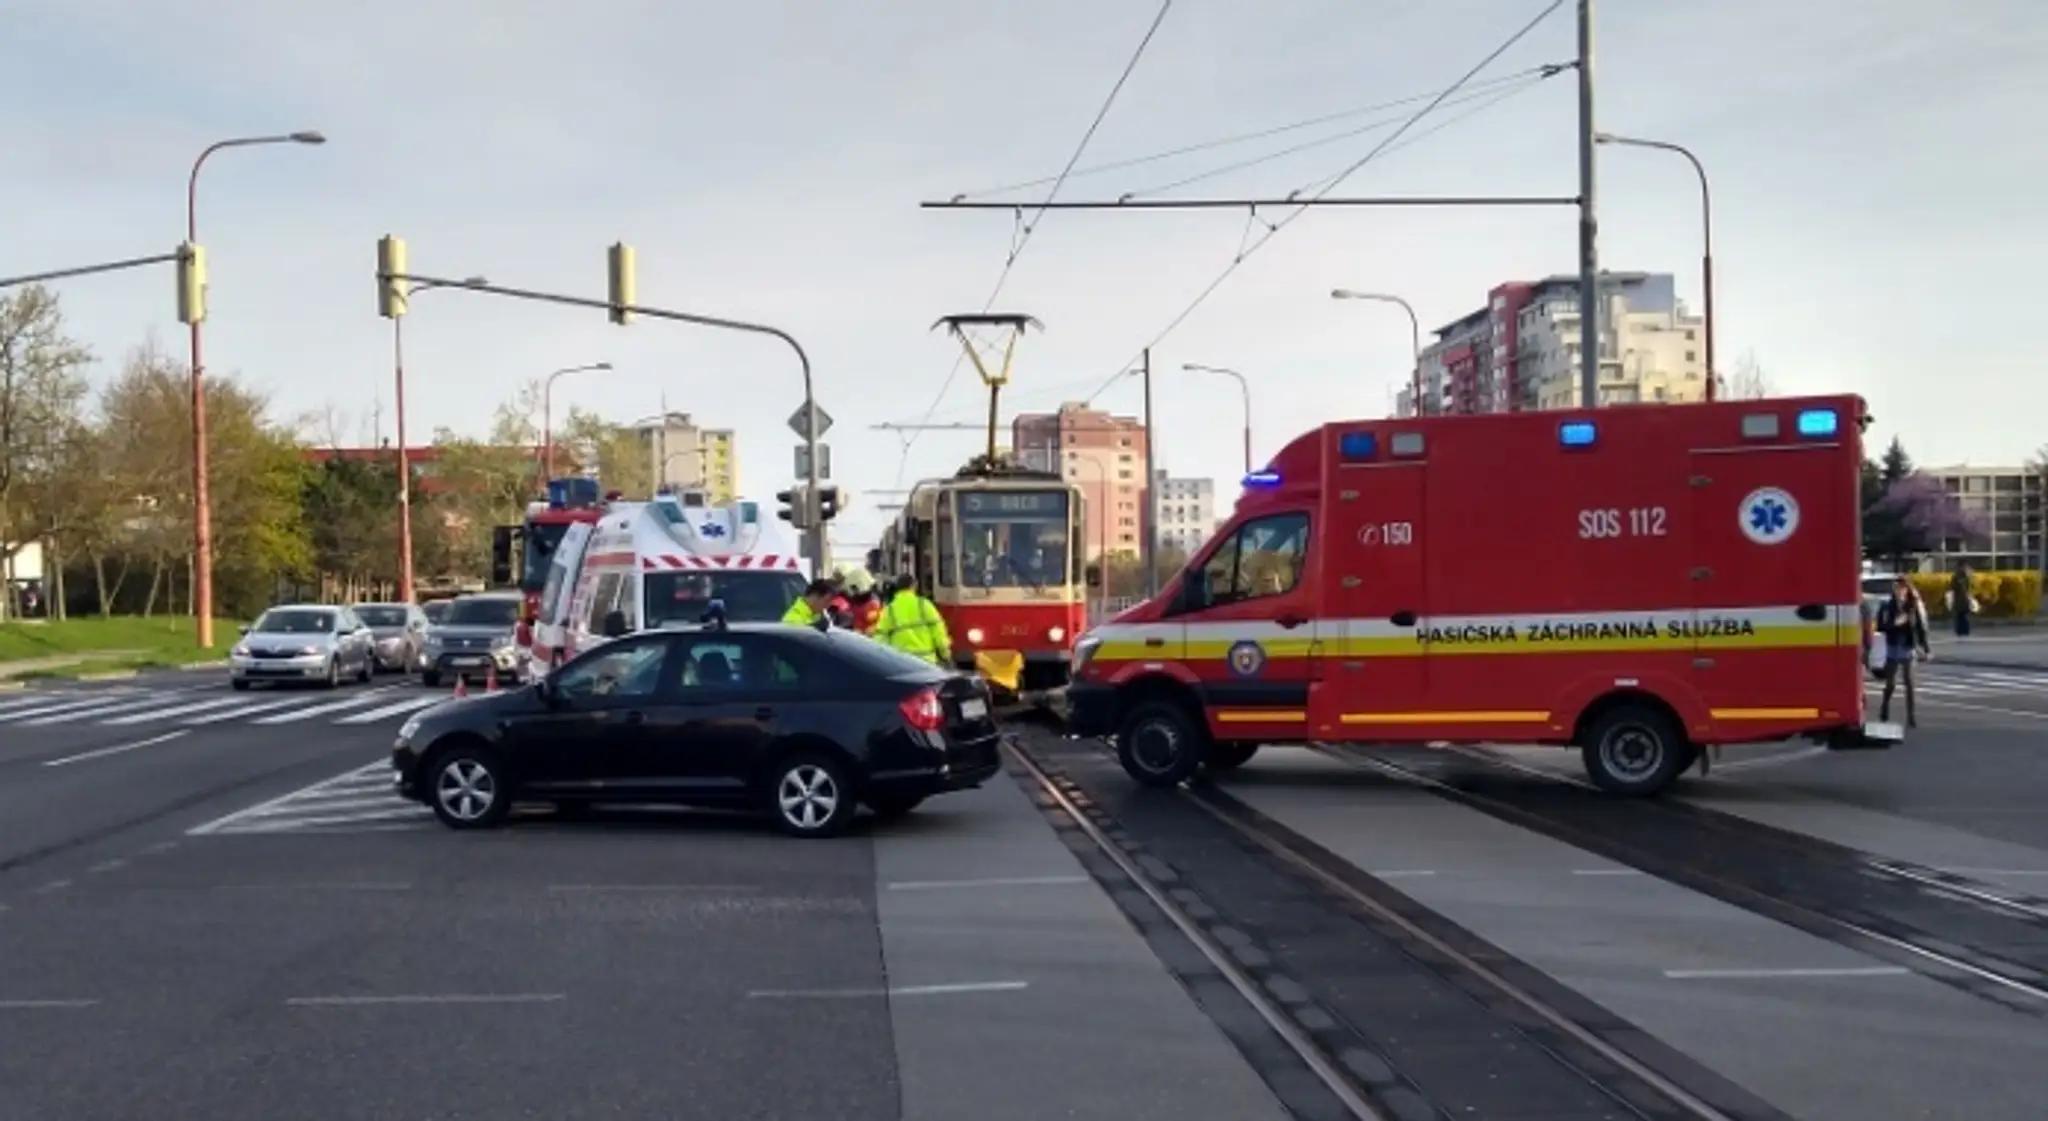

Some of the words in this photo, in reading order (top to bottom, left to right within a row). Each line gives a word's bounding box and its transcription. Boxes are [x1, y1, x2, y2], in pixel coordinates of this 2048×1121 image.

[1381, 521, 1412, 546] 150
[1578, 508, 1621, 539] SOS
[1628, 506, 1666, 537] 112
[1526, 616, 1658, 642] ZÁCHRANNÁ
[1667, 614, 1754, 639] SLUŽBA
